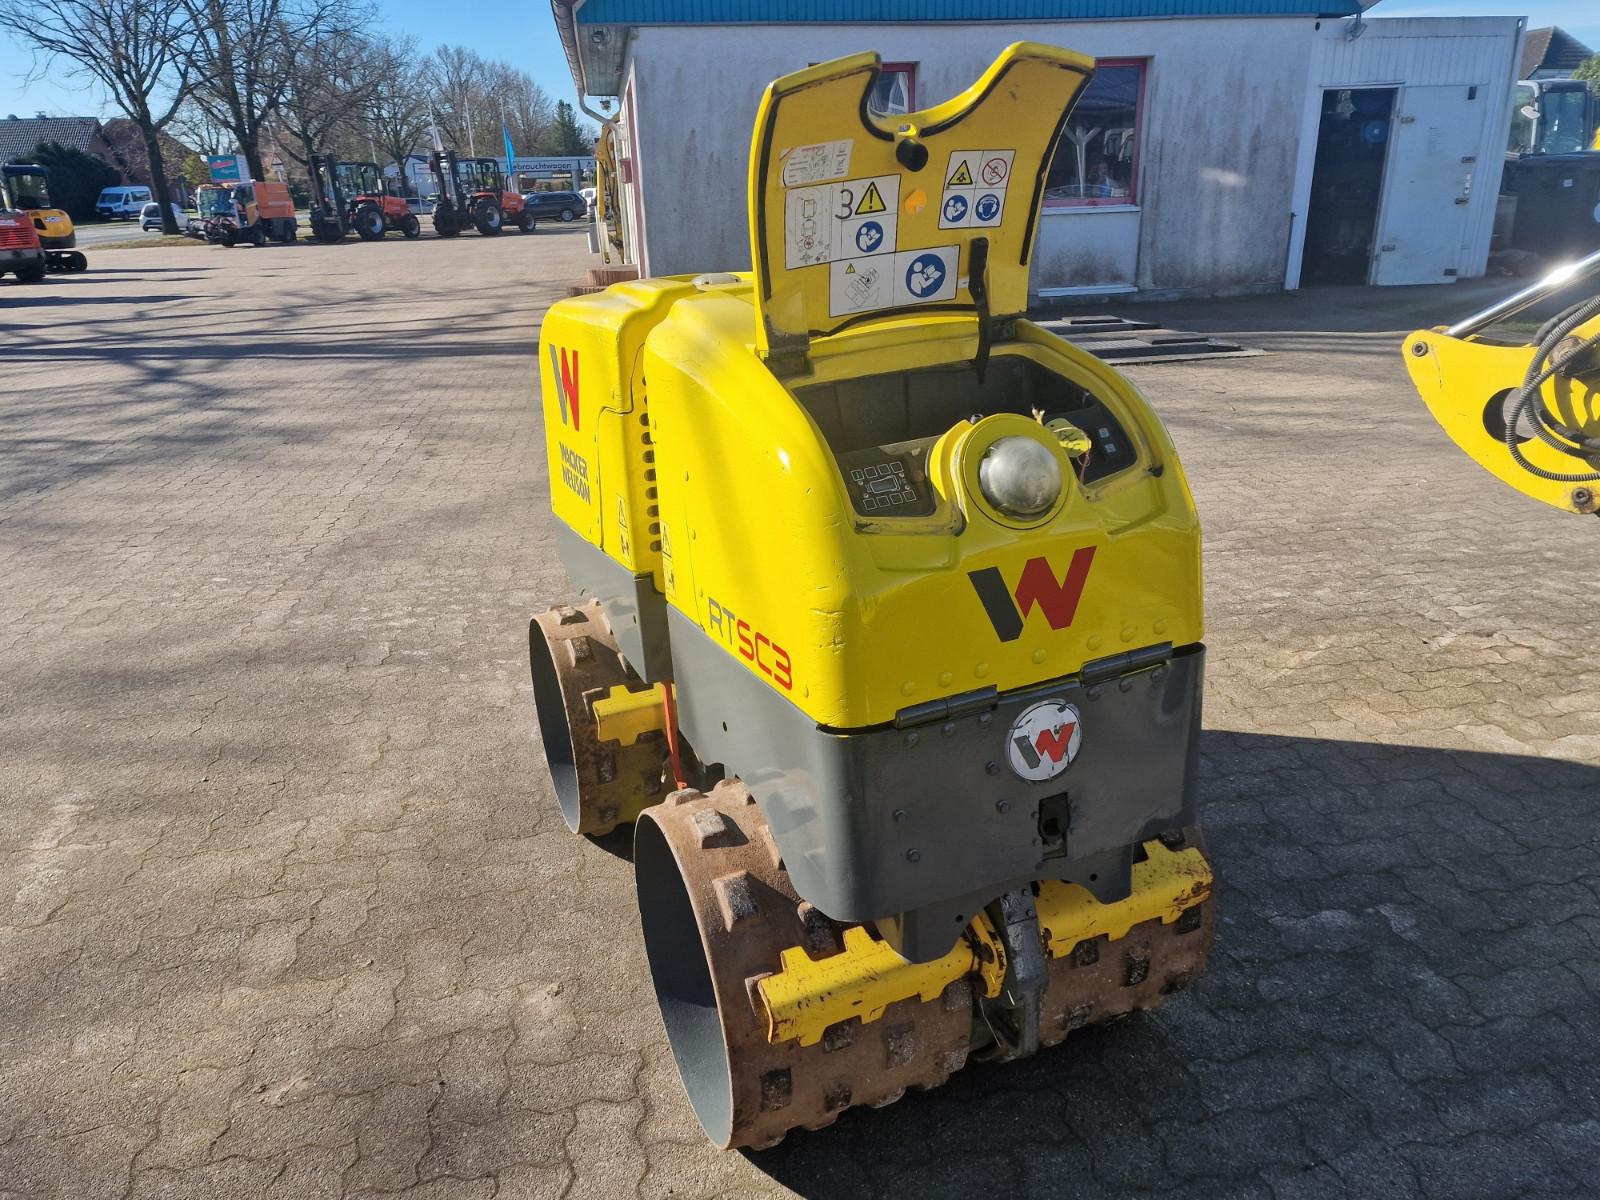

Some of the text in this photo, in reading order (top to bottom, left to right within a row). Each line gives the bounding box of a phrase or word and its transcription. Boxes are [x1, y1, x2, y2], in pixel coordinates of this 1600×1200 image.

[835, 189, 854, 220] 3
[559, 441, 588, 481] WACKER
[562, 464, 591, 505] NEUSON
[967, 545, 1097, 642] W
[1013, 721, 1076, 770] W
